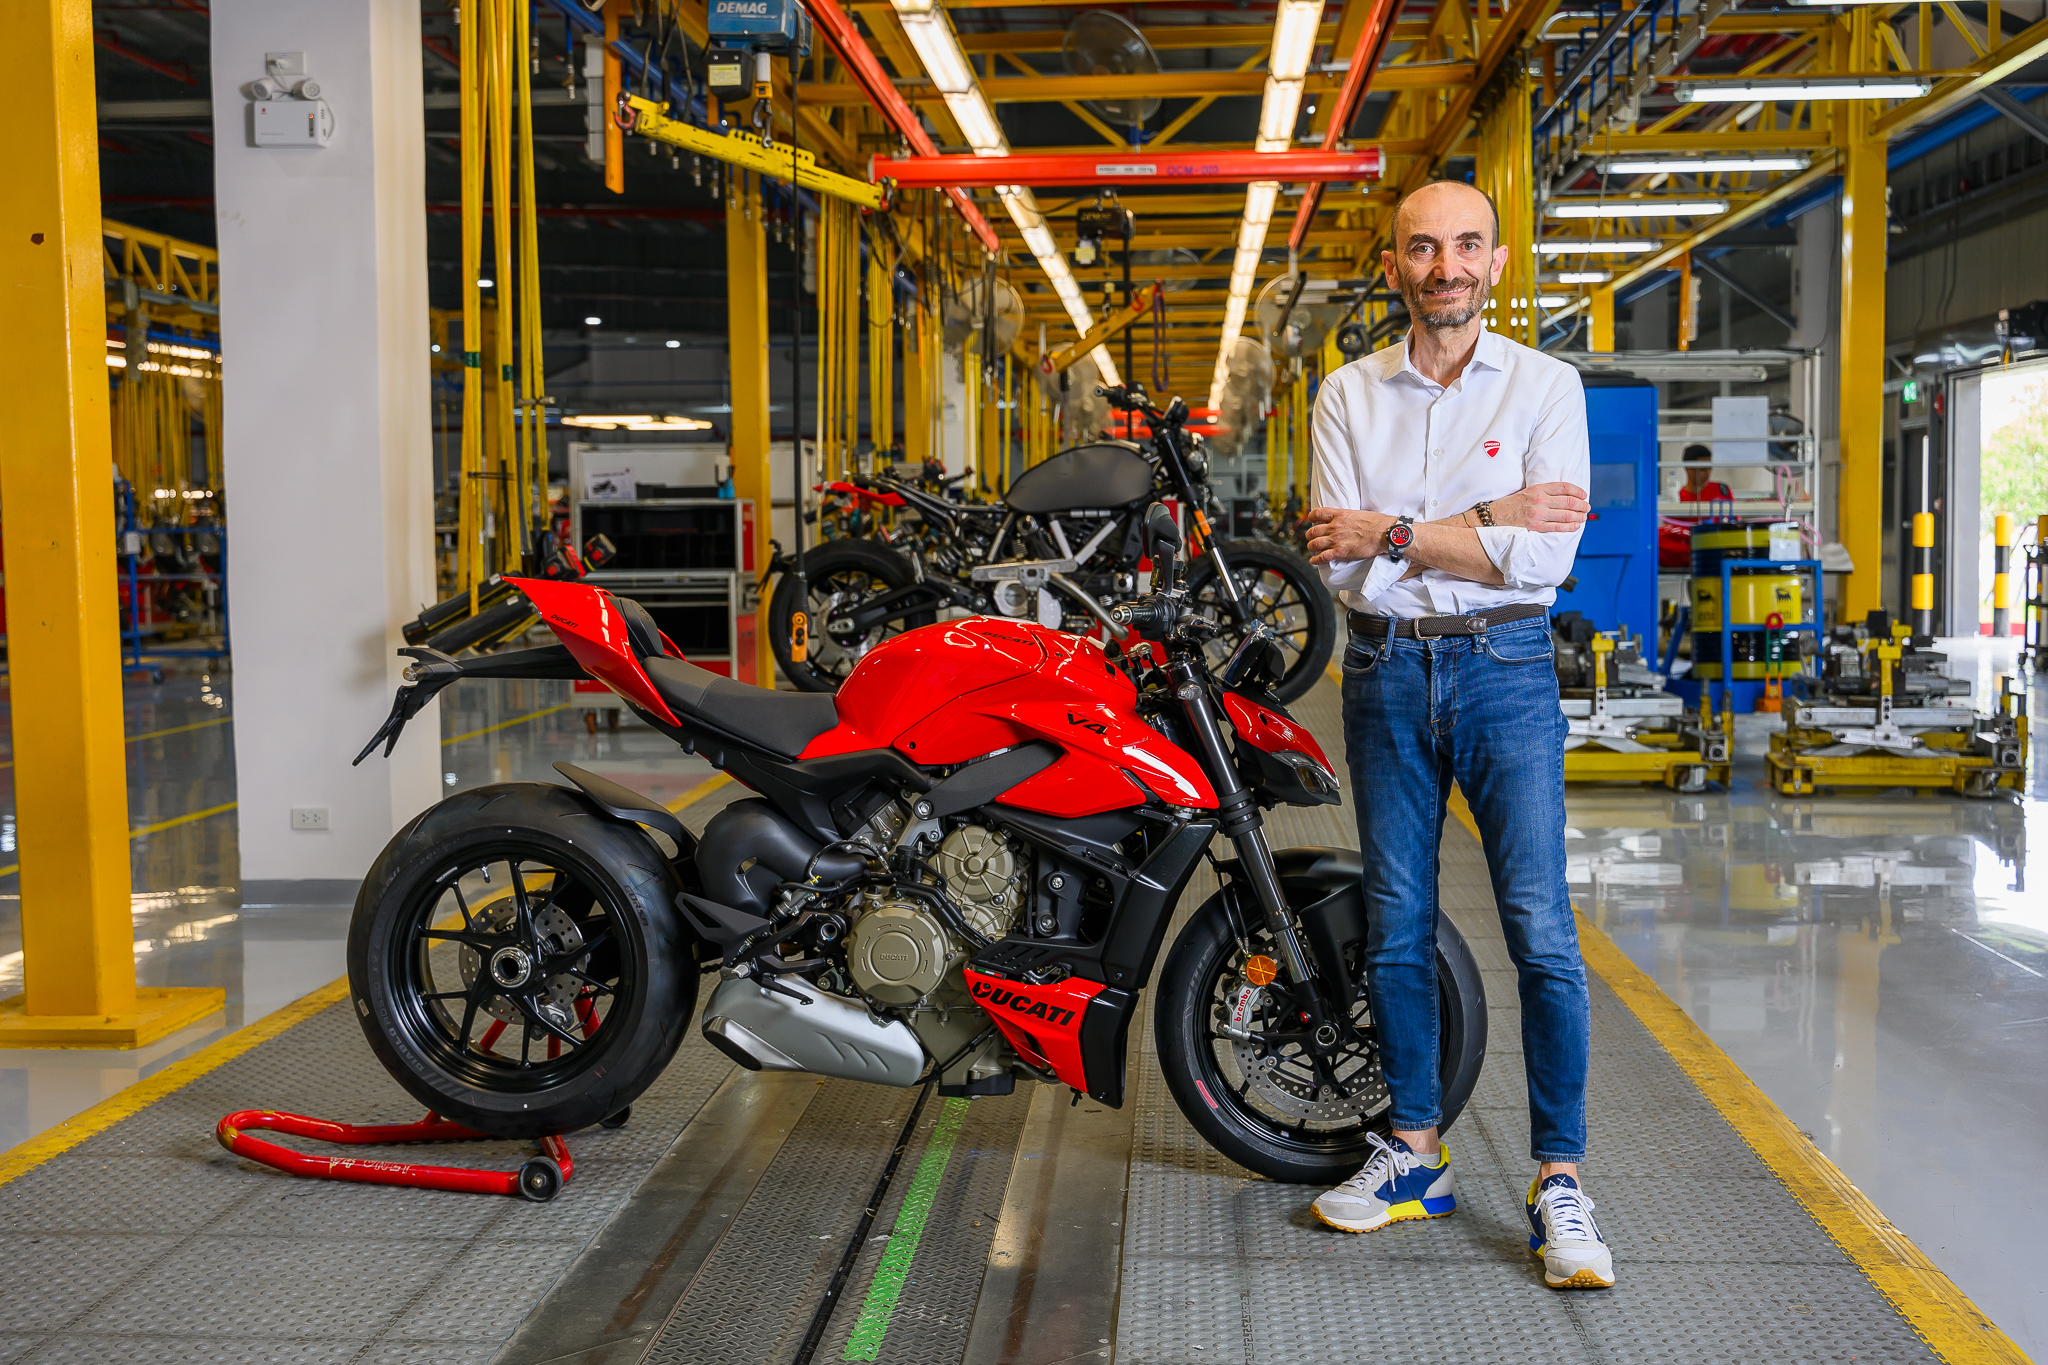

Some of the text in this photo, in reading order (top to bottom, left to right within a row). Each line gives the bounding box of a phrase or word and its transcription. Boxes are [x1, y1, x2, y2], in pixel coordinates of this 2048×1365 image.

[716, 2, 767, 14] DEMAG
[550, 614, 578, 628] DUCATI
[981, 631, 1035, 646] DUCATI
[1067, 711, 1107, 736] V4
[623, 884, 649, 927] CORSA
[879, 953, 909, 962] DUCATI
[971, 981, 1077, 1027] DUCATI
[1234, 989, 1251, 1022] brembo
[388, 1027, 425, 1072] DIABLO
